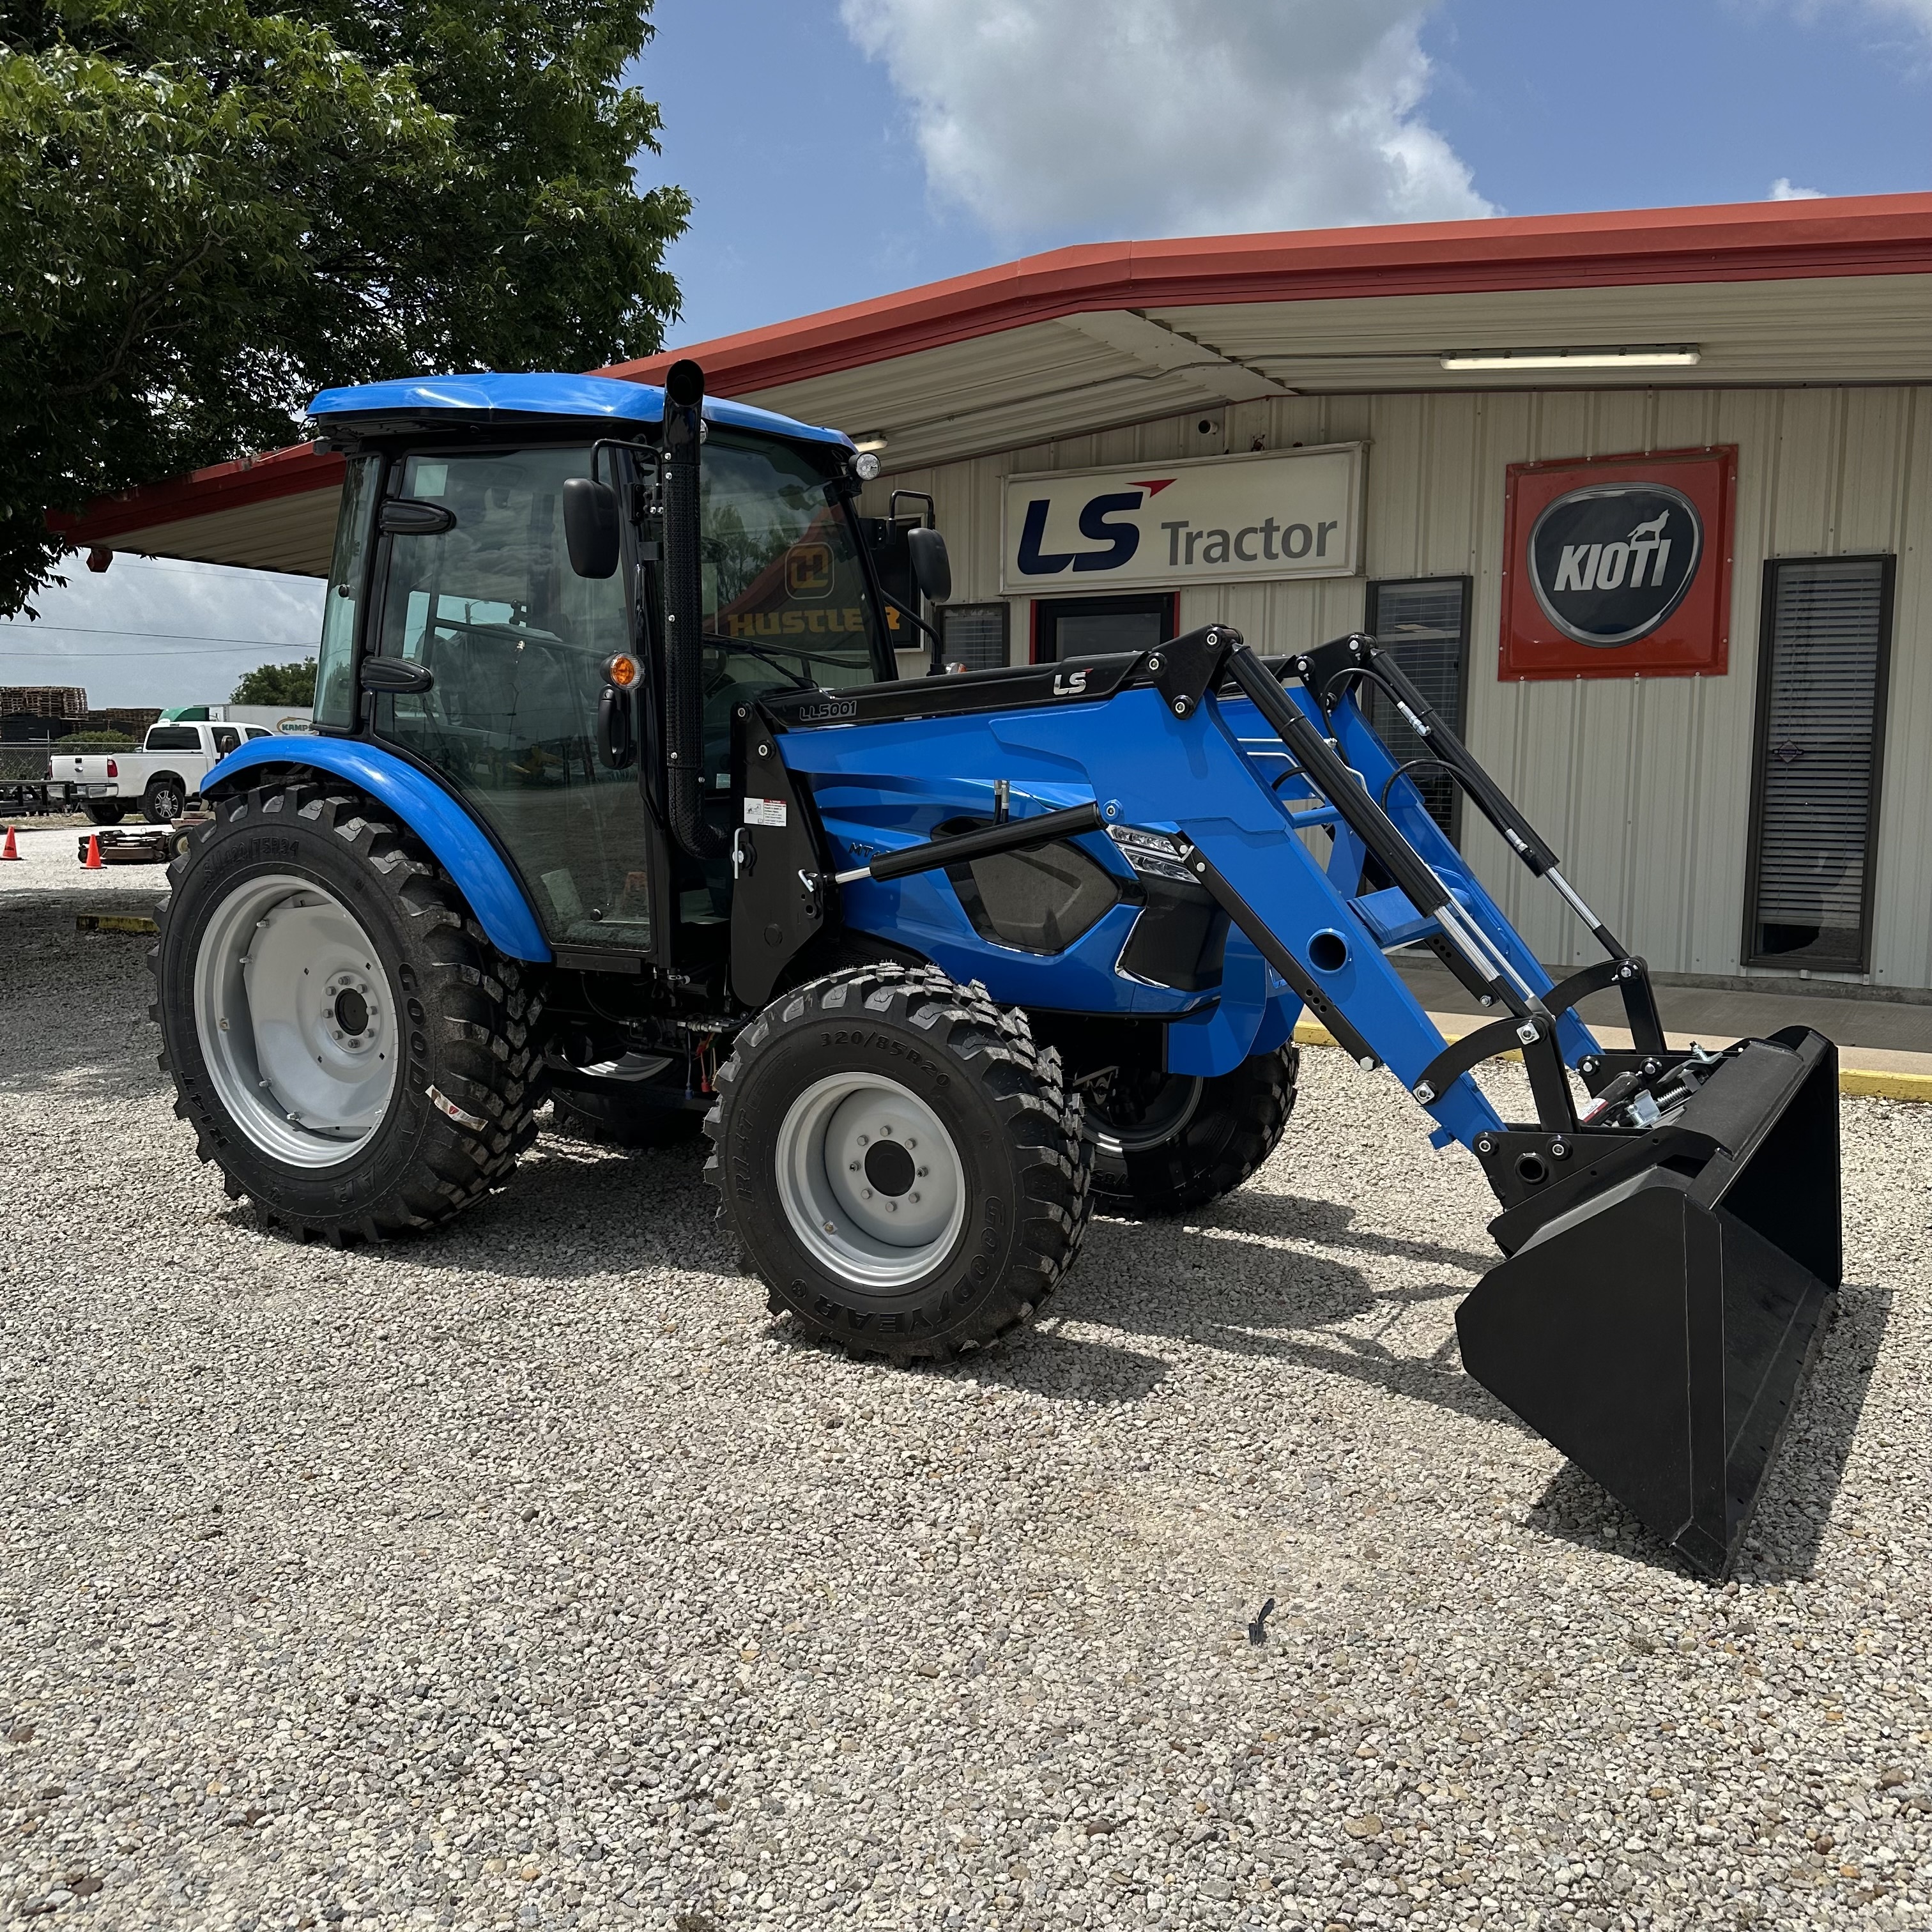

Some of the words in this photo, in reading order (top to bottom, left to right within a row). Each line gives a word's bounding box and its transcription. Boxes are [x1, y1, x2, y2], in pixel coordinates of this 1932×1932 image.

[1017, 491, 1144, 576] LS
[1161, 516, 1338, 567] Tractor
[1553, 539, 1672, 592] KIOTI
[799, 700, 857, 721] LL5001
[1053, 671, 1087, 695] LS
[820, 1030, 951, 1087] 320/85R20
[813, 1195, 1006, 1334] GOODYEAR
